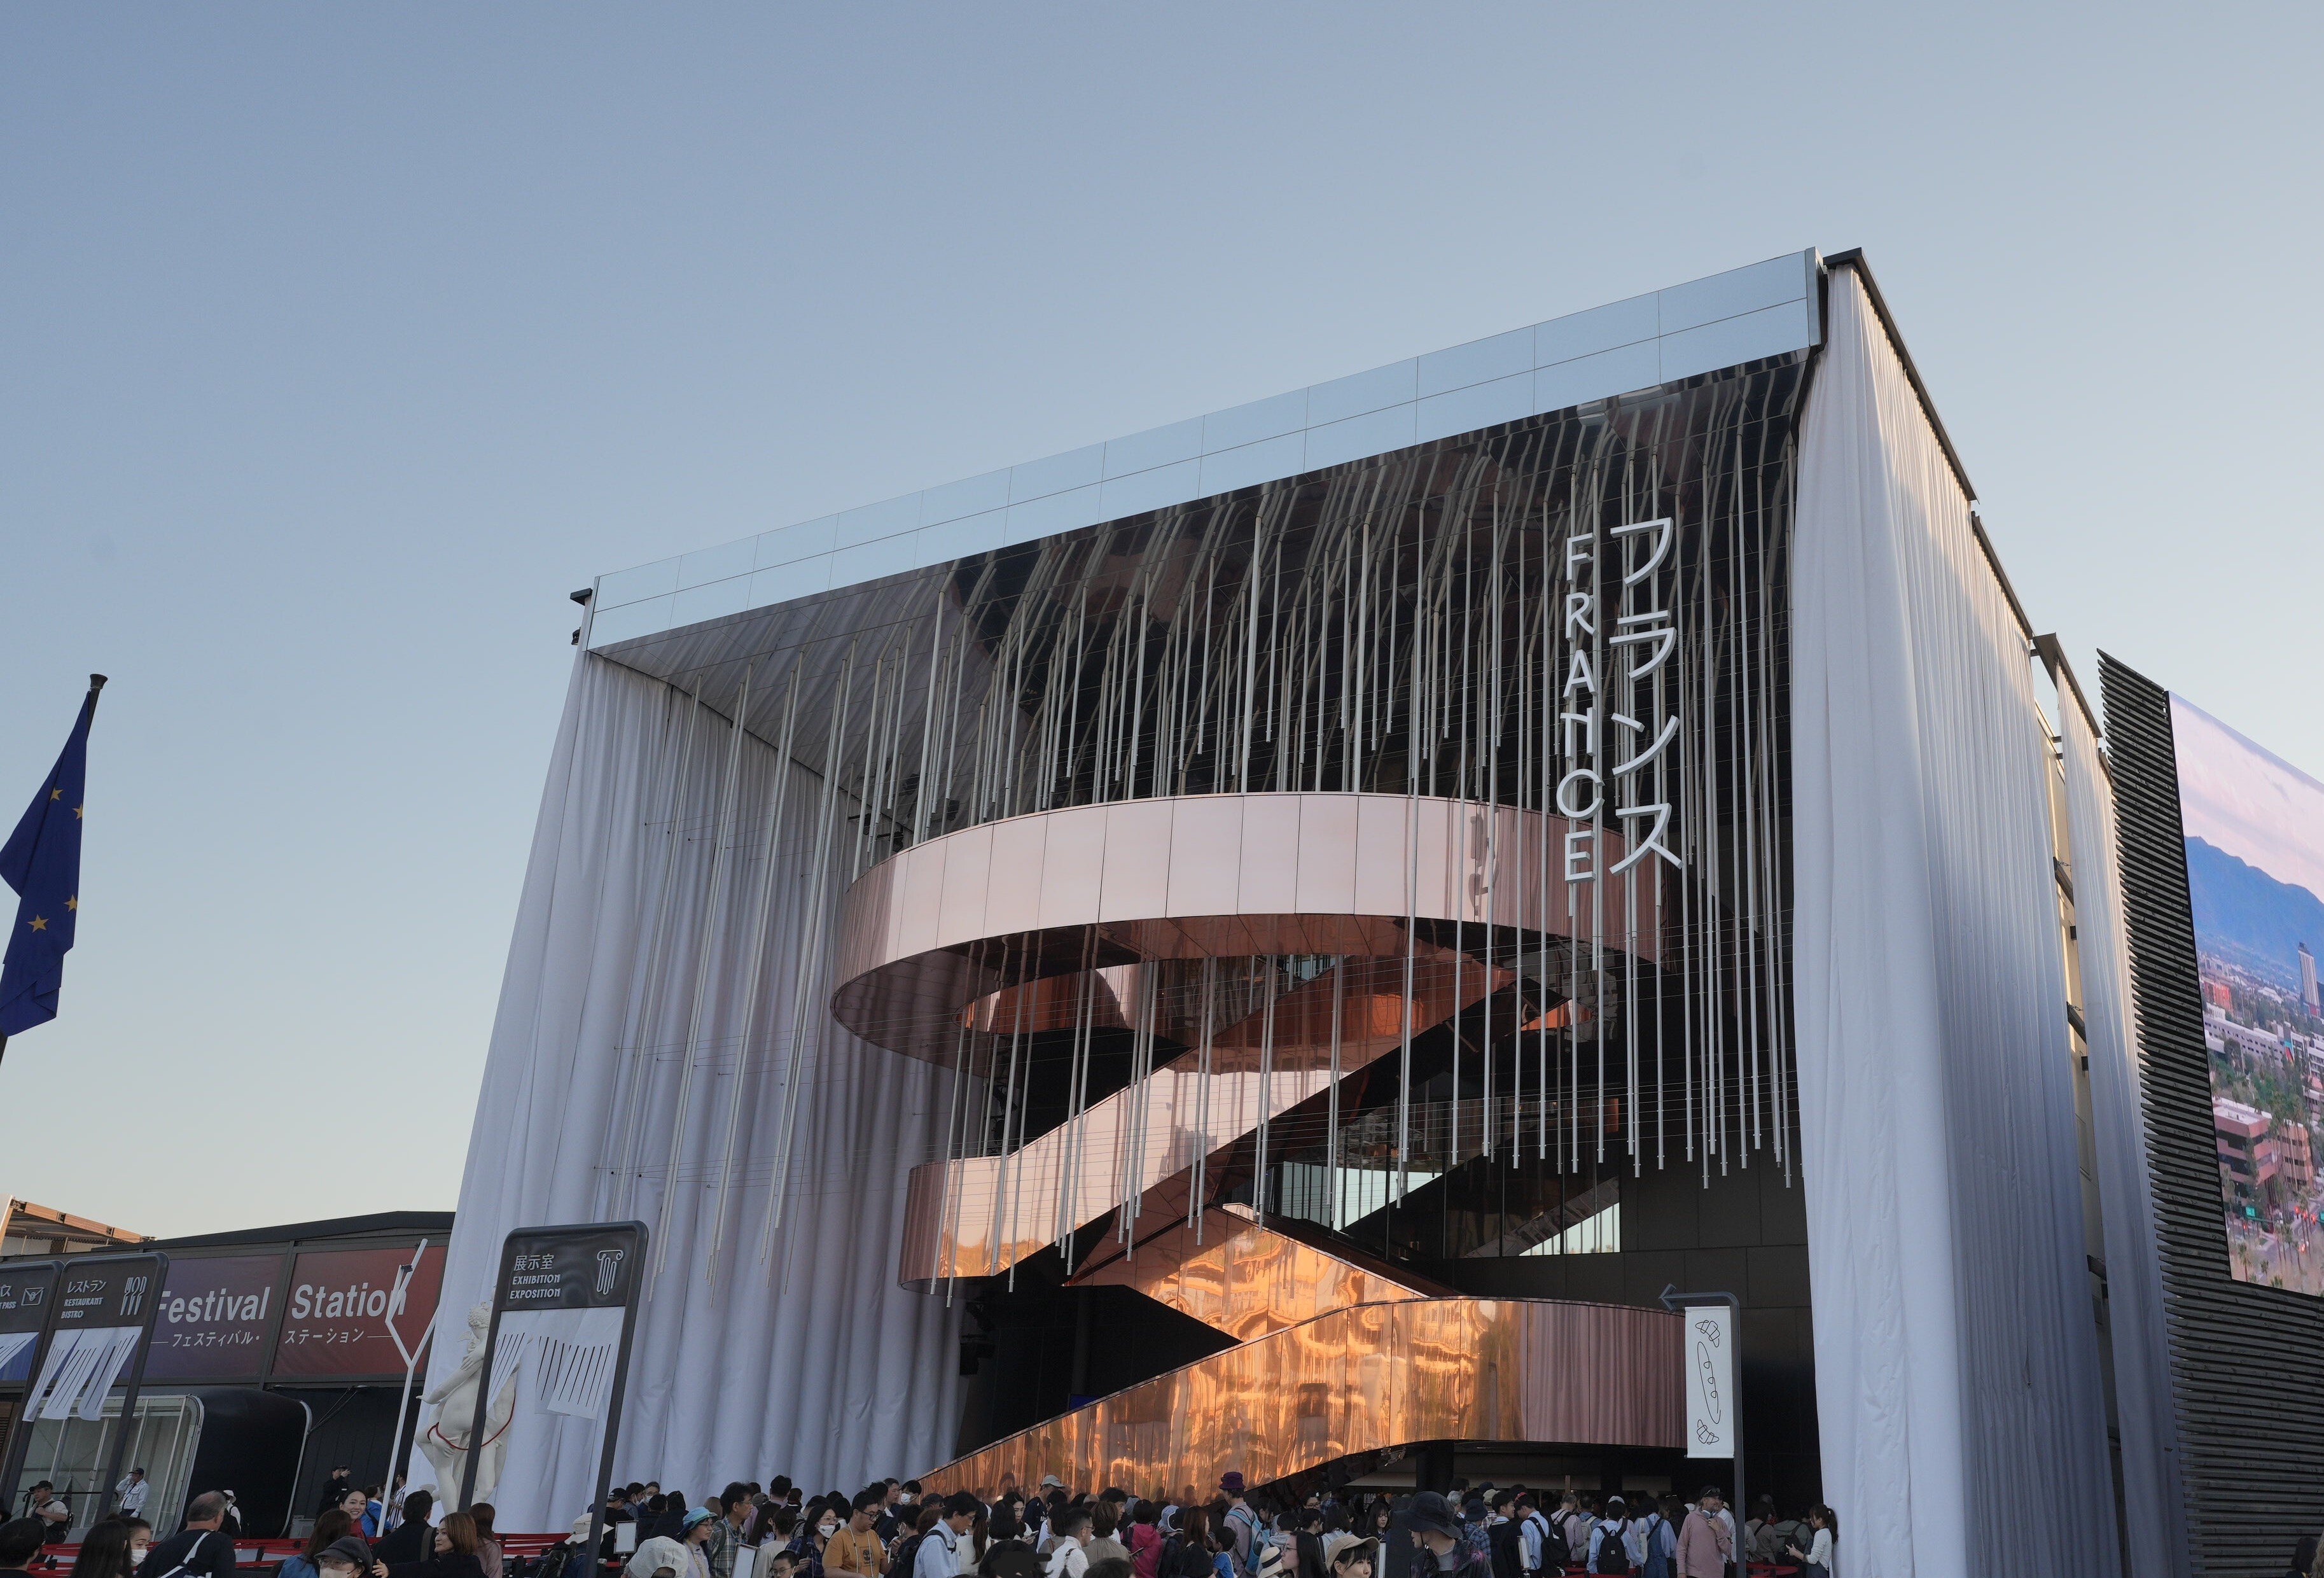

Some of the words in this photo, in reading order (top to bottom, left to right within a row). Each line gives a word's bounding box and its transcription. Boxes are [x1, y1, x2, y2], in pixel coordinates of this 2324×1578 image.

[1609, 517, 1683, 877] フランス
[1556, 533, 1604, 884] FRANCE
[513, 1253, 554, 1271] 展示室
[512, 1274, 561, 1285] EXHIBITION
[67, 1280, 107, 1294] レストラン
[510, 1288, 561, 1299] EXPOSITION
[64, 1297, 104, 1307] RESTAURANT
[60, 1310, 85, 1319] BISTRO
[284, 1327, 365, 1345] ステーション
